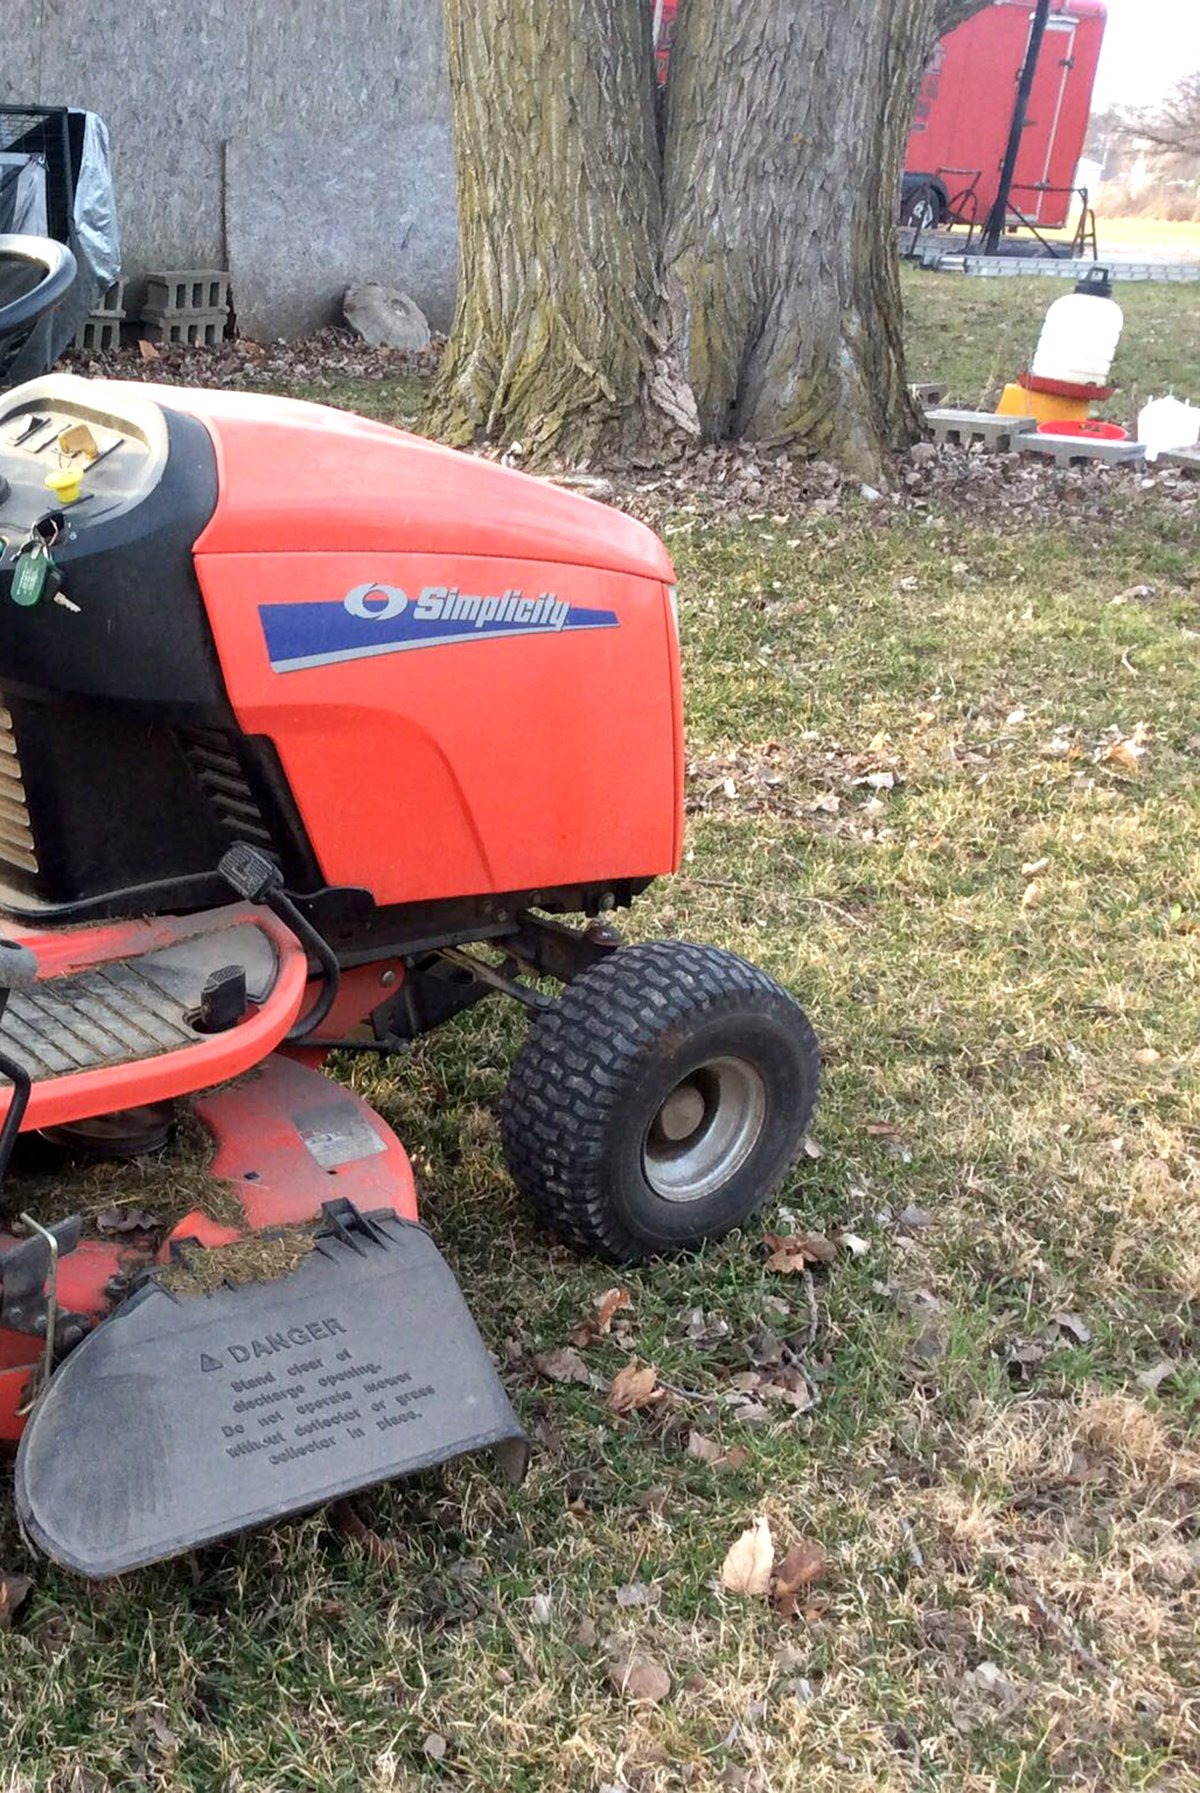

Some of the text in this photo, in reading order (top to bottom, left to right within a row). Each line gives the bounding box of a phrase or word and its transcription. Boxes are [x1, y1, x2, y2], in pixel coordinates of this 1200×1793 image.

[413, 586, 570, 631] Simplicity
[227, 1317, 347, 1363] DANGER
[231, 1371, 276, 1393] Stand
[287, 1357, 324, 1379] clear
[221, 1370, 413, 1439] Do not operate mower
[232, 1383, 306, 1414] discharge
[293, 1406, 361, 1439] deflector
[370, 1398, 387, 1413] or
[395, 1383, 436, 1407] grass
[268, 1434, 337, 1466] collector
